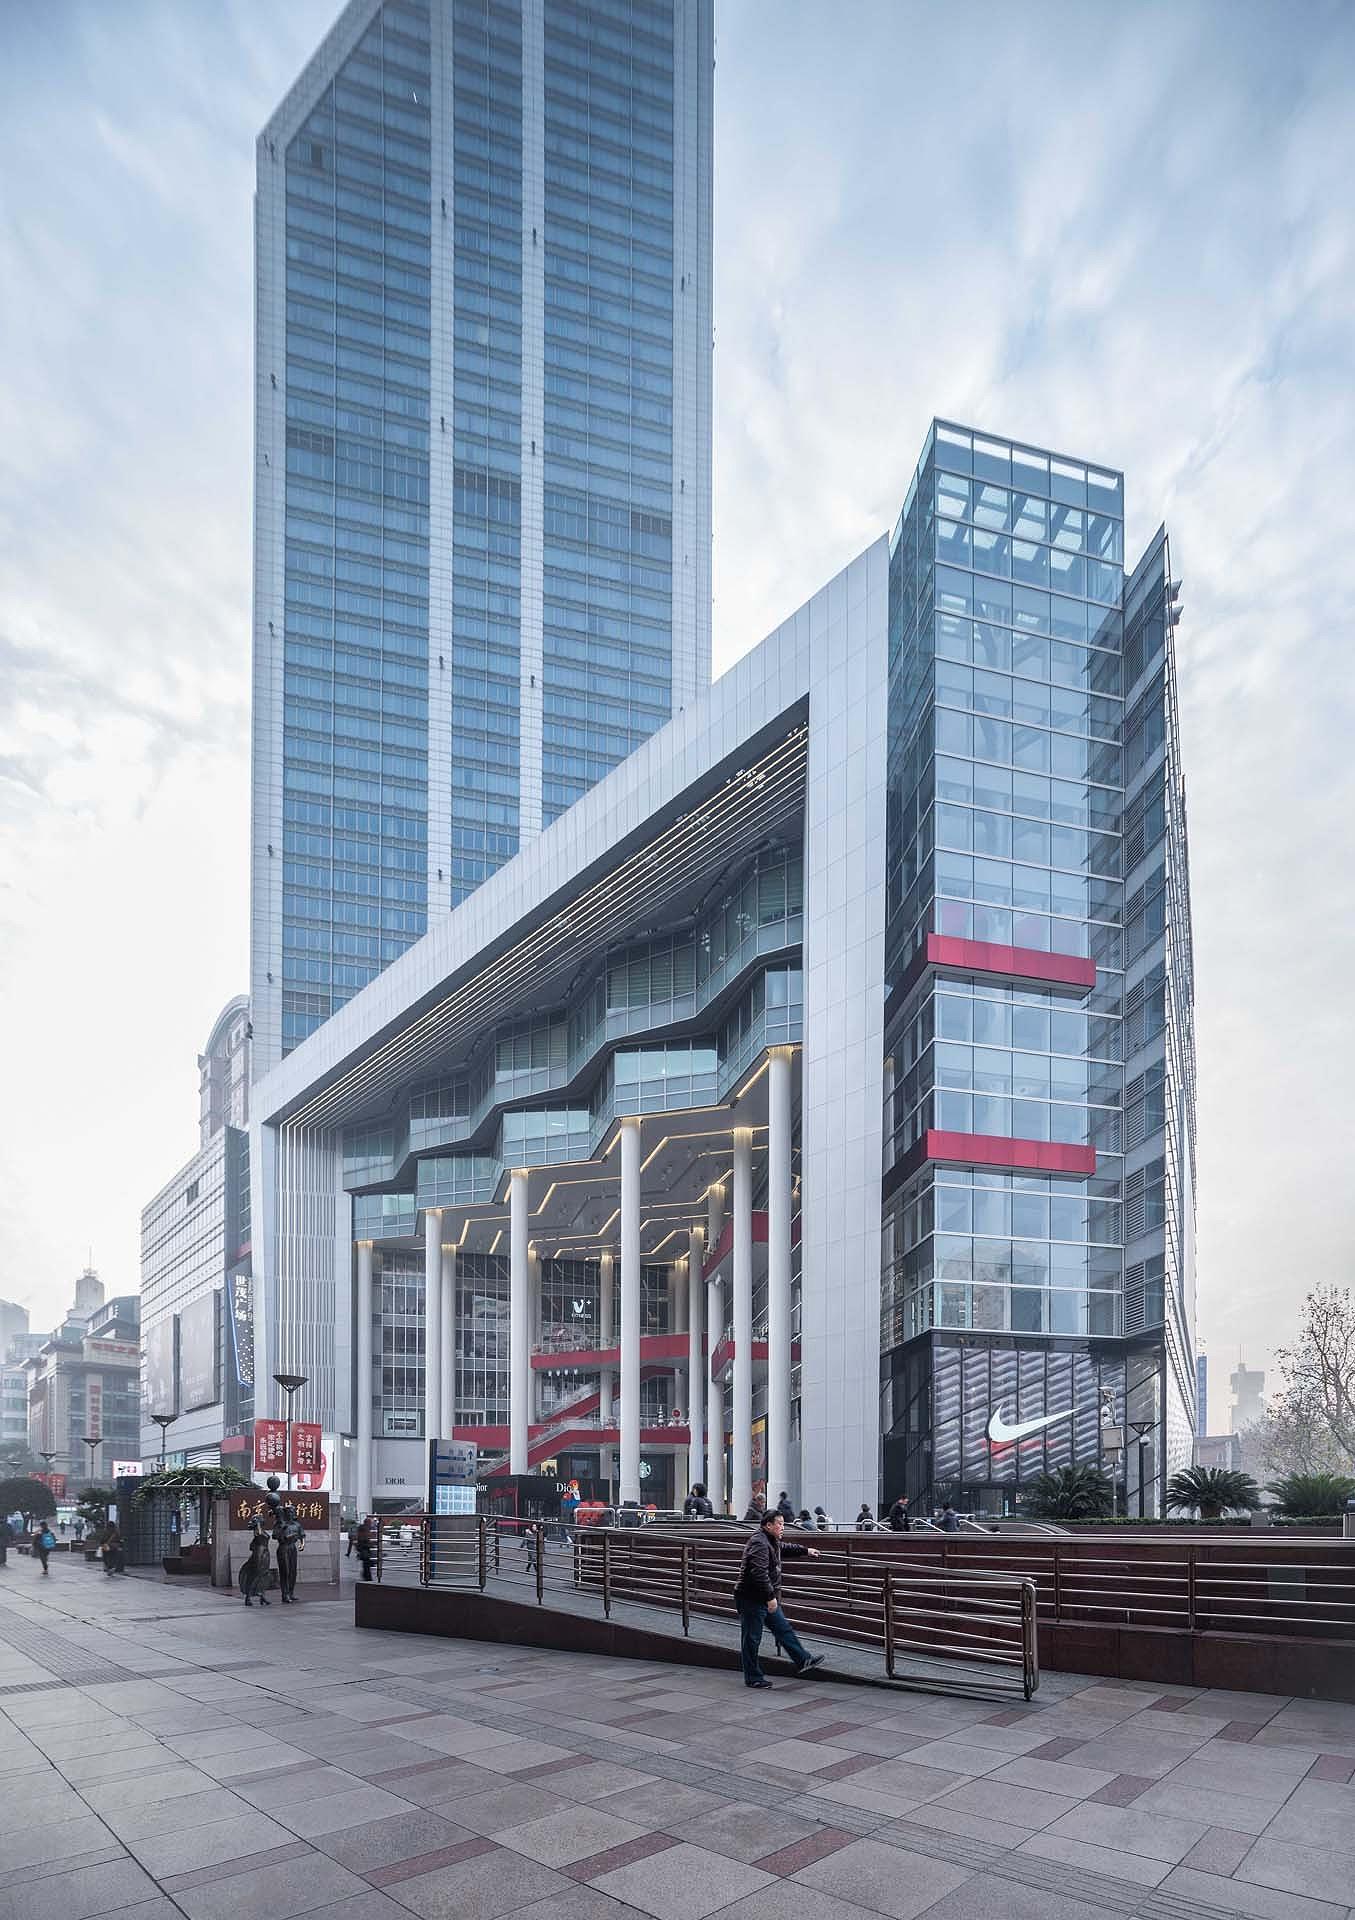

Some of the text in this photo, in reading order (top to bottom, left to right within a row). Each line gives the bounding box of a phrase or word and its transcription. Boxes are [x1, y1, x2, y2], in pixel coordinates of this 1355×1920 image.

[235, 1275, 248, 1321] 世茂广场
[385, 1477, 406, 1485] DIOR
[237, 1500, 323, 1520] 南京行街
